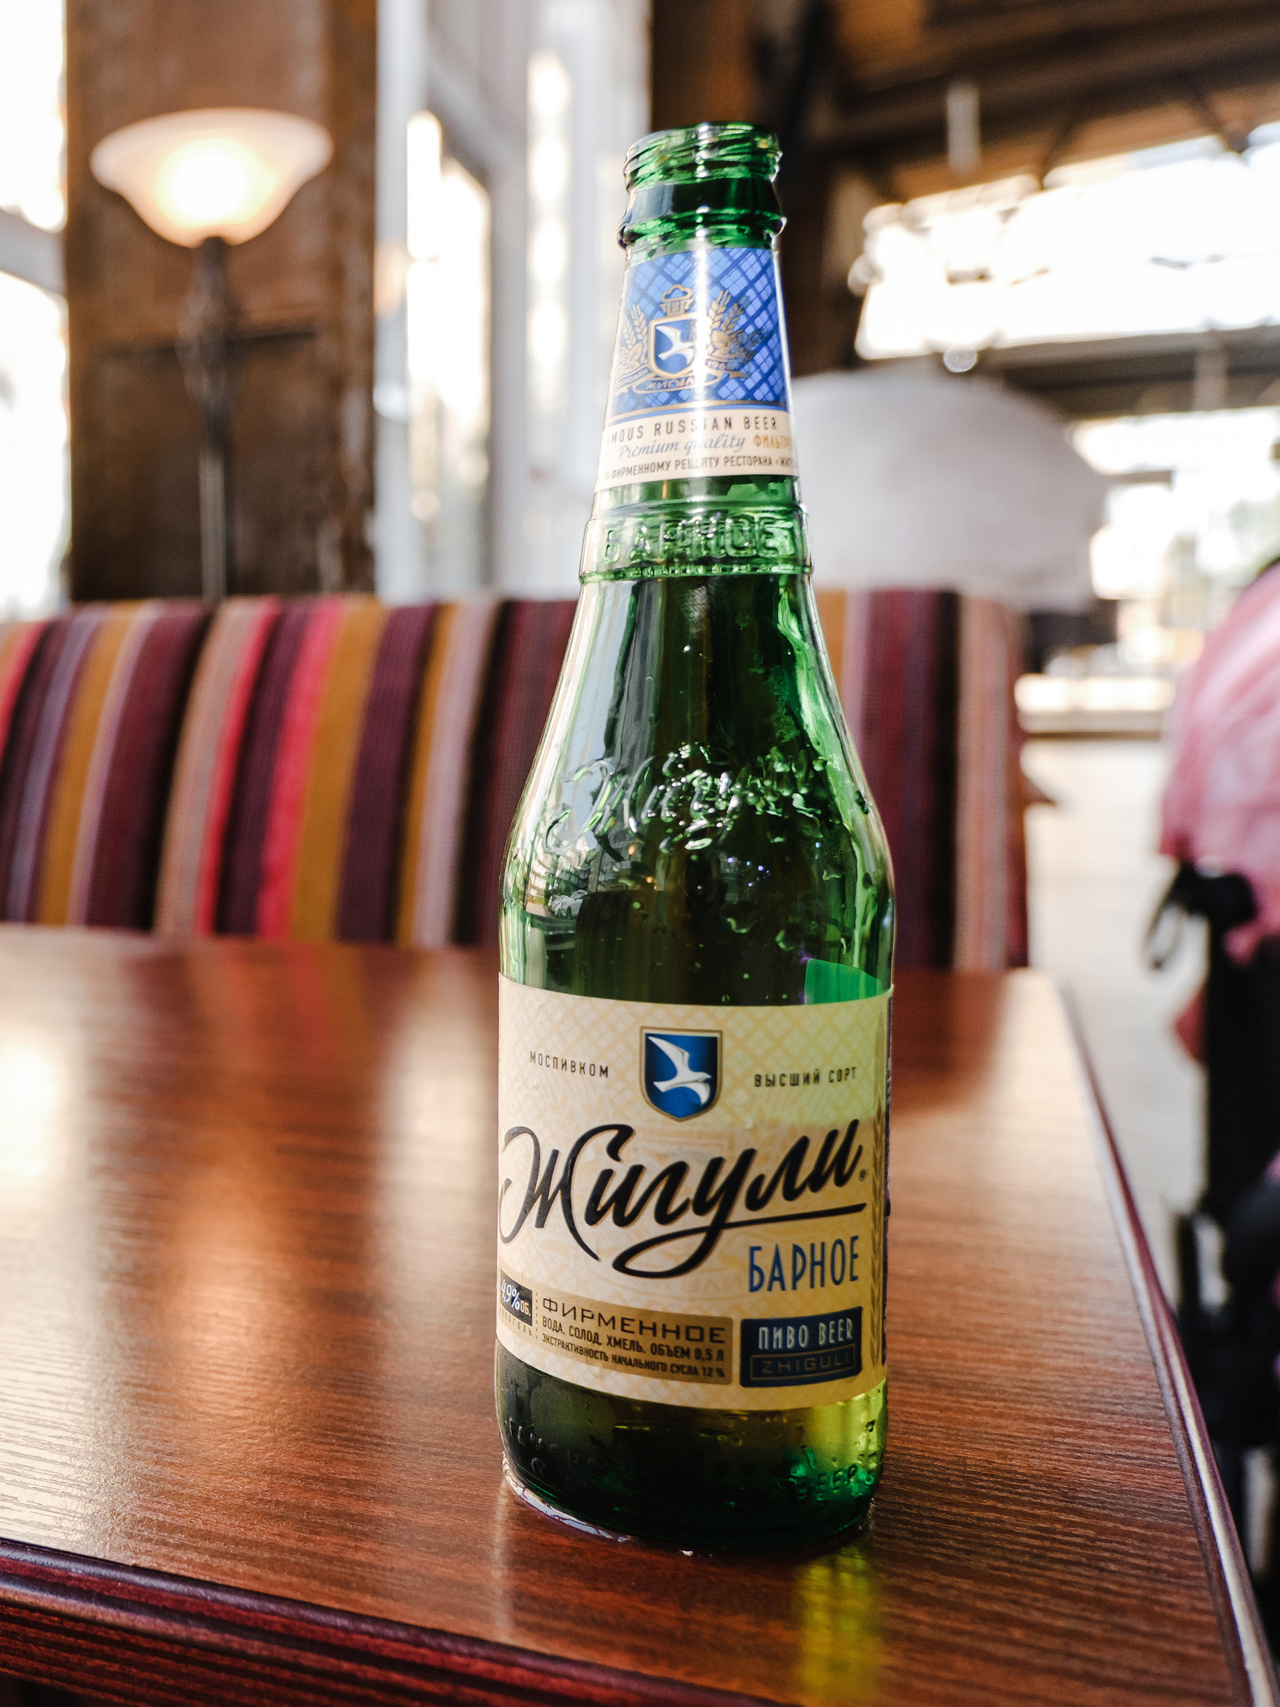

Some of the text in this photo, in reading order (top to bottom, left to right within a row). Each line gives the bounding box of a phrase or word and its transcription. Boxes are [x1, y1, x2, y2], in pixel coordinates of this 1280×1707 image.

[645, 376, 697, 391] ЖИГУЛ
[608, 416, 778, 446] MOUS RUSSIAN BEER
[619, 439, 680, 460] Premium
[611, 459, 671, 480] ФИРМЕННОМУ
[724, 455, 773, 469] РЕСТОРАНА
[529, 1050, 609, 1079] МОСПИВКОМ
[754, 1066, 857, 1088] ВЫСШИЙ СОРТ
[499, 1119, 867, 1279] Жигули
[749, 1235, 859, 1293] БАРНОЕ
[542, 1298, 725, 1344] ФИРМЕННОЕ
[758, 1317, 853, 1350] ПИВО BEER
[542, 1333, 725, 1378] ЭКСТРАКТИВНОСТЬ НАЧАЛЬНОГО СУСЛА 12 %
[650, 1343, 690, 1359] ОБЪЕМ
[761, 1352, 850, 1374] ZHIGULI
